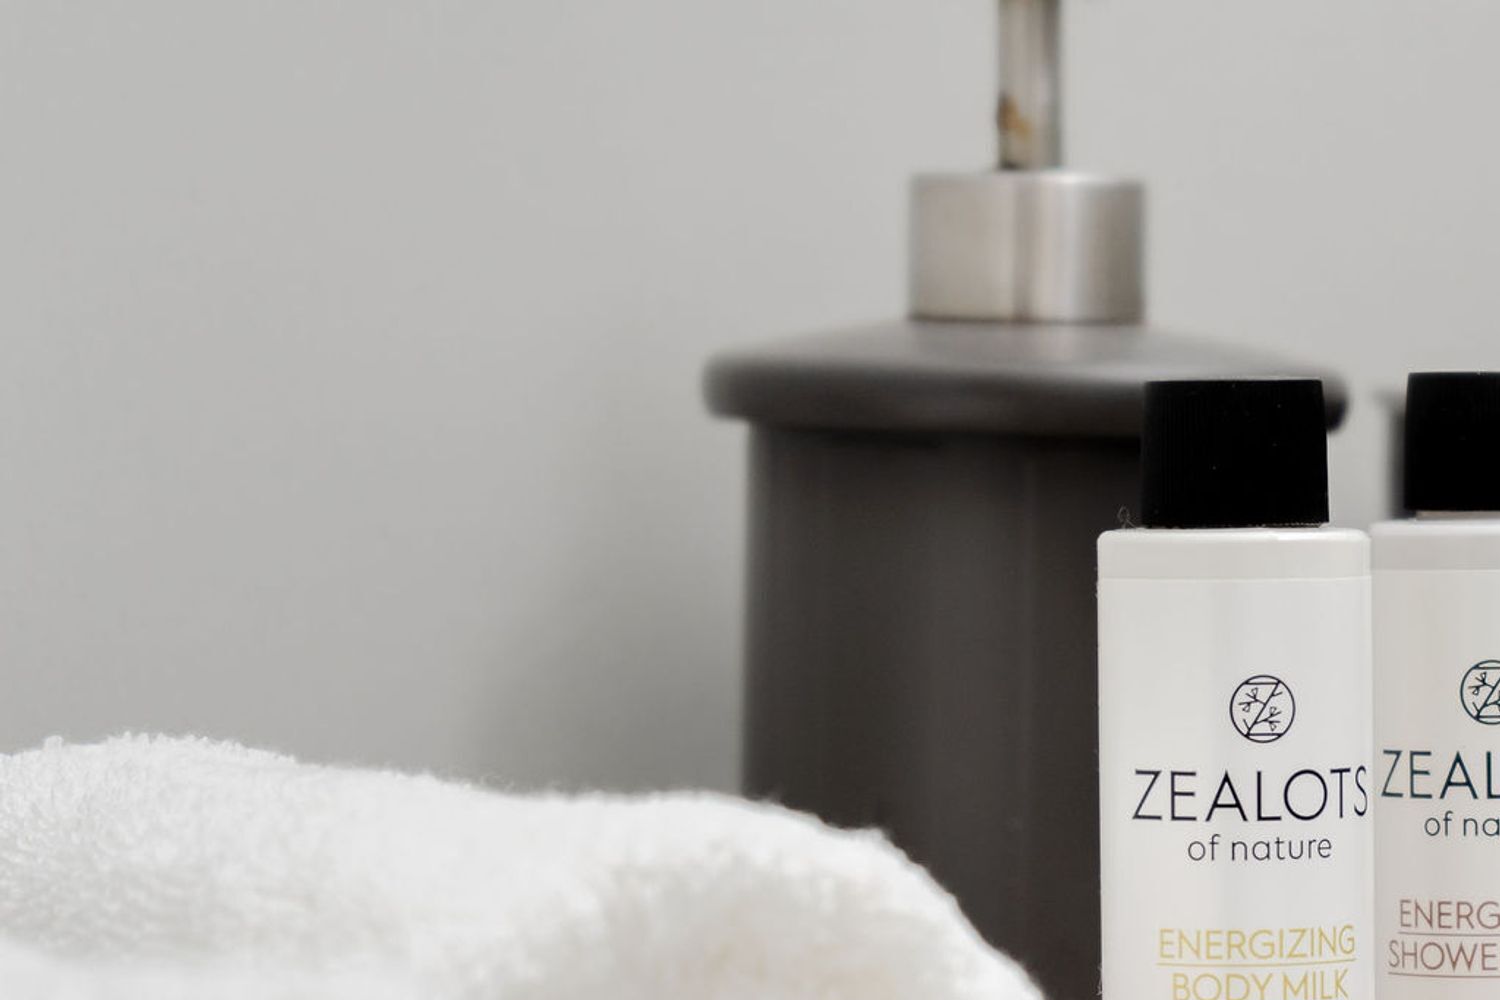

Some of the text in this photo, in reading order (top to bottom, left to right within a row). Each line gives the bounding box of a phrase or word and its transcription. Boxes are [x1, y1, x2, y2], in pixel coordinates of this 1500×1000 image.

[1132, 765, 1368, 822] ZEALOTS
[1424, 810, 1454, 837] of
[1187, 834, 1332, 861] of nature
[1158, 925, 1356, 960] ENERGIZING
